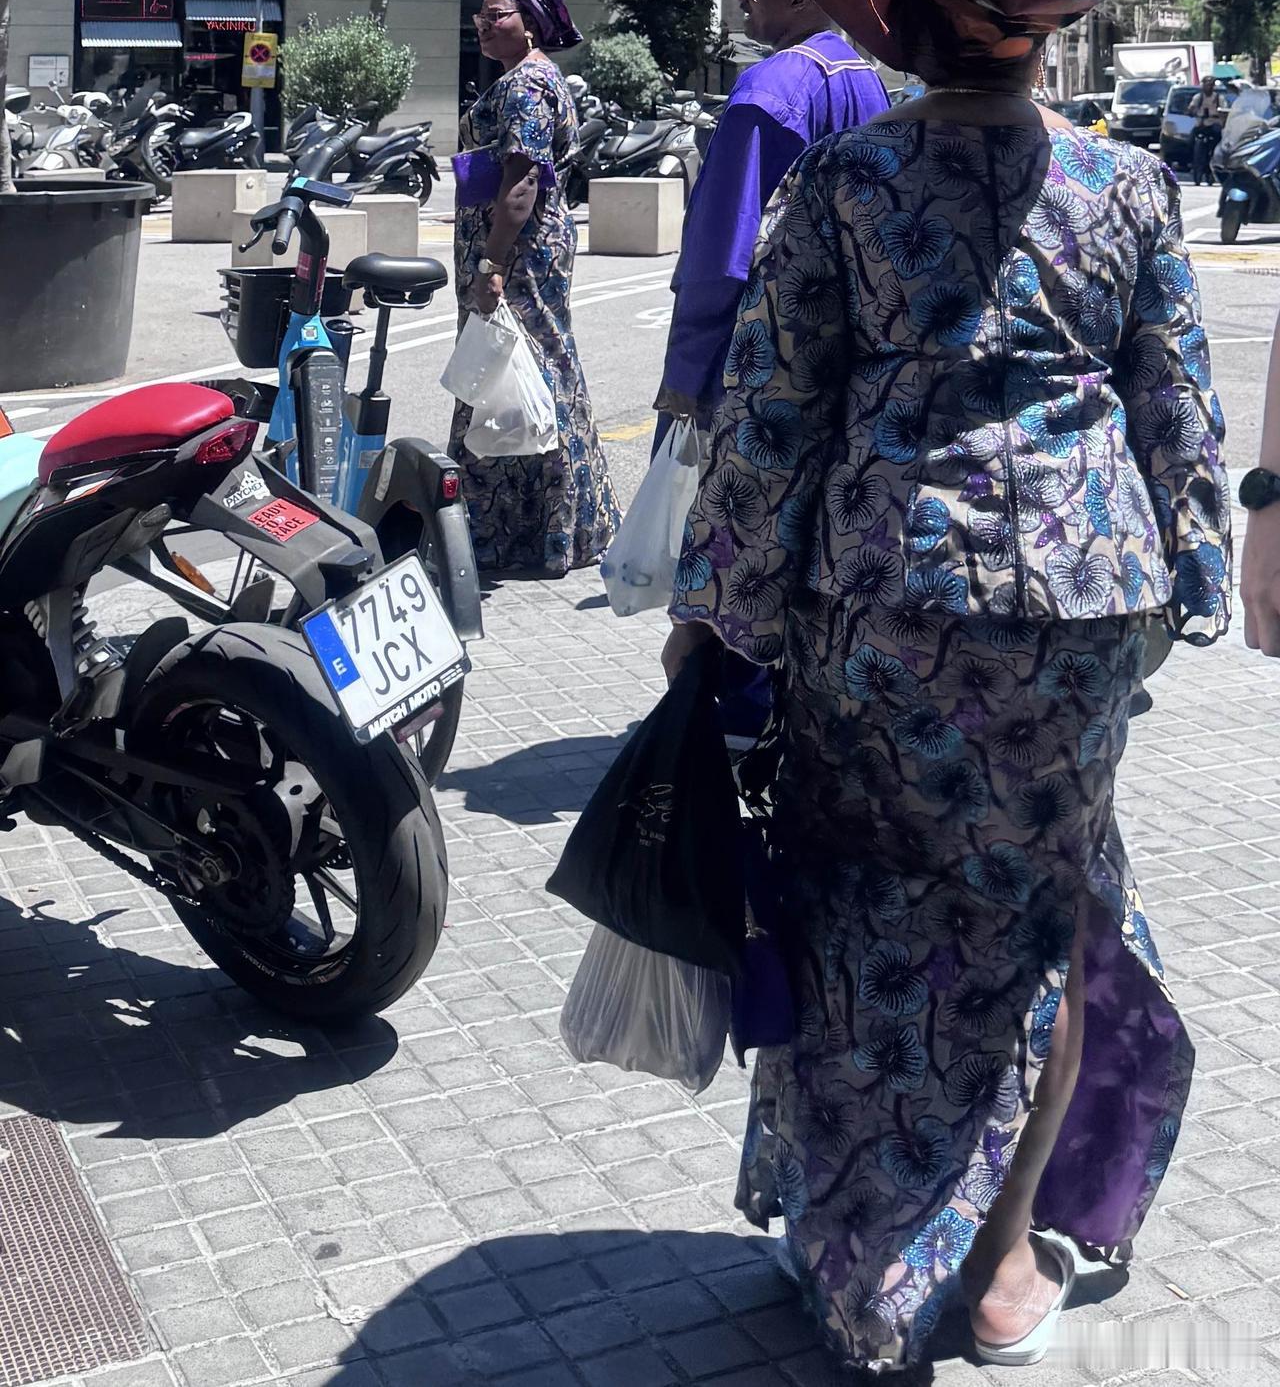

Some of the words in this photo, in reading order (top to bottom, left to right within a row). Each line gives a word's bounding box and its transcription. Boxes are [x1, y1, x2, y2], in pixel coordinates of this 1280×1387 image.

[206, 21, 256, 31] YAKINIKU
[251, 503, 287, 526] EADY
[258, 517, 279, 532] TO
[338, 573, 426, 655] 7749
[332, 657, 348, 676] E
[371, 626, 433, 696] JCX
[368, 702, 408, 740] MATCH
[408, 680, 441, 712] MOTO
